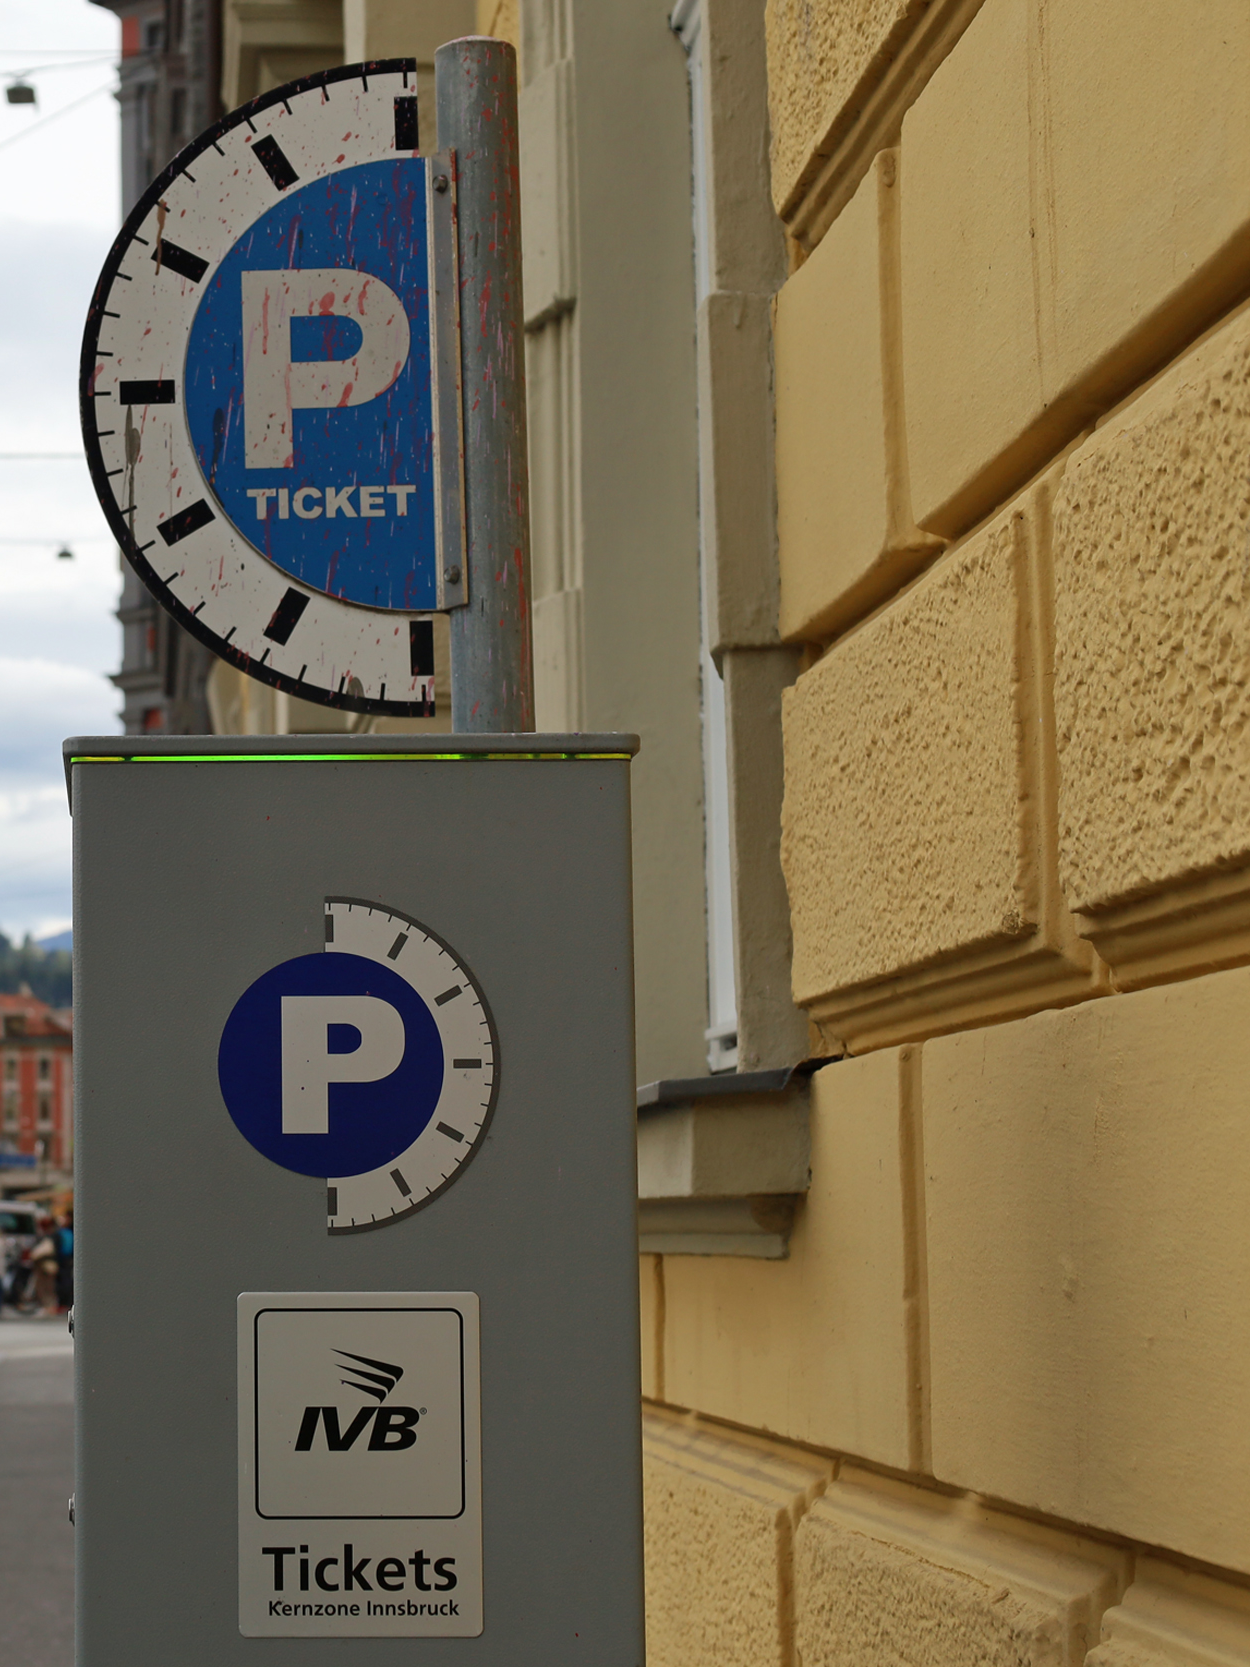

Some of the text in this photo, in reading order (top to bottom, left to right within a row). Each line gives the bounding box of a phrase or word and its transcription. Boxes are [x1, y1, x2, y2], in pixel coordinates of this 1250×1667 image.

[241, 268, 411, 469] P
[246, 485, 416, 520] TICKET
[281, 995, 406, 1135] P
[294, 1406, 420, 1452] IVB
[261, 1543, 458, 1592] Tickets
[268, 1599, 460, 1617] Kernzone Innsbruck
